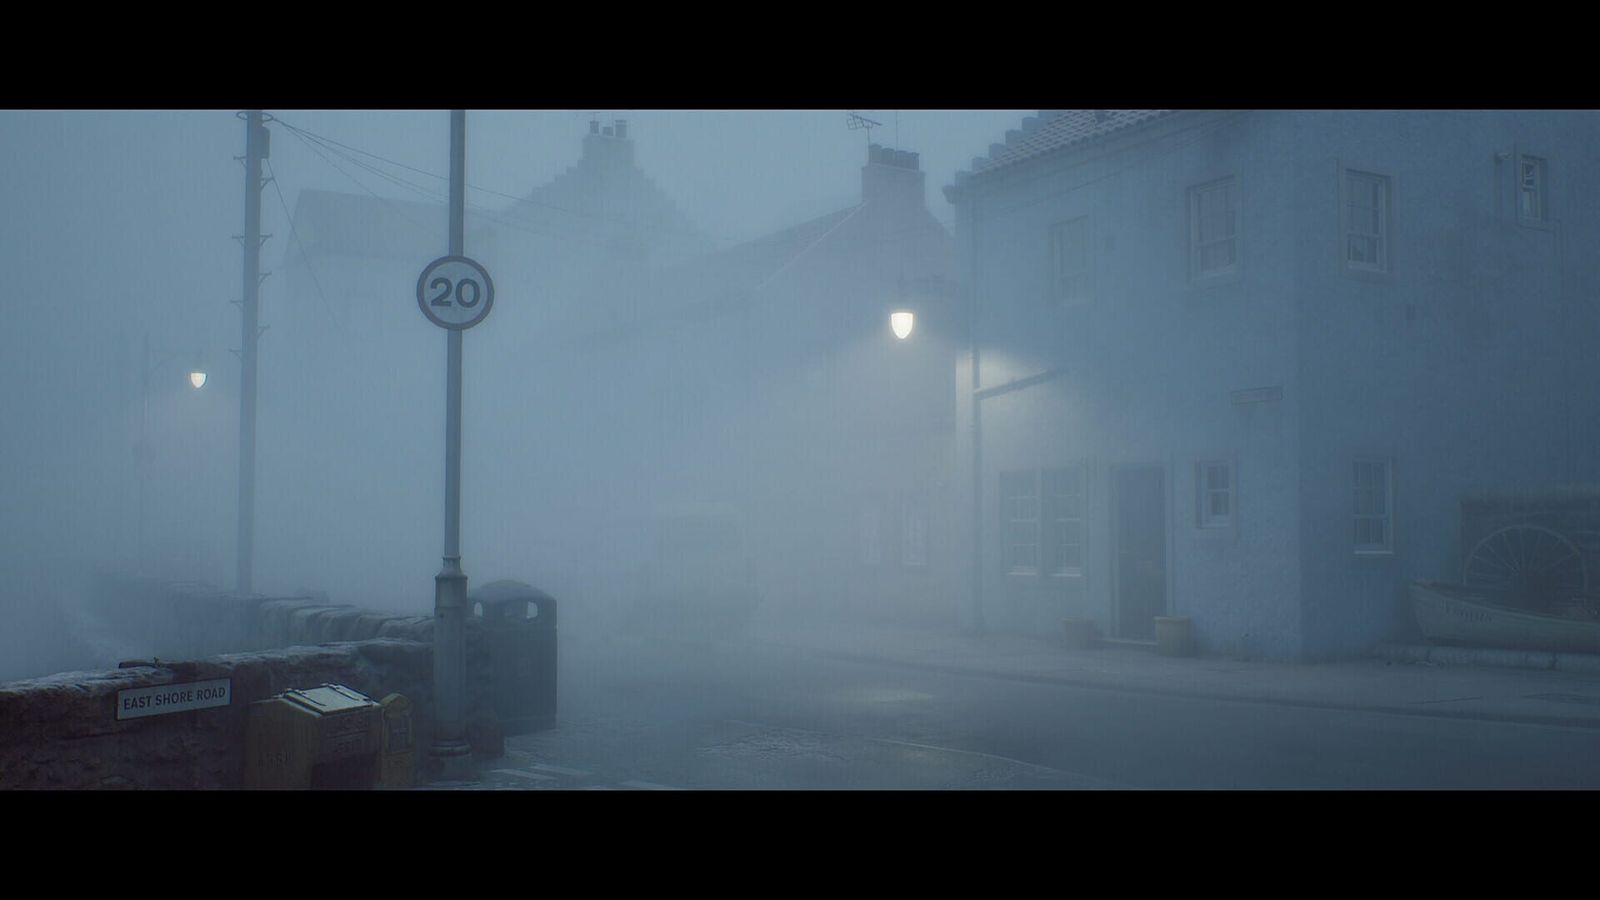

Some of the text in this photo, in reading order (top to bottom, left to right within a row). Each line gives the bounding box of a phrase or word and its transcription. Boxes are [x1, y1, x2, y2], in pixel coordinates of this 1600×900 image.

[430, 277, 480, 308] 20
[123, 687, 226, 710] EAST SHORE ROAD
